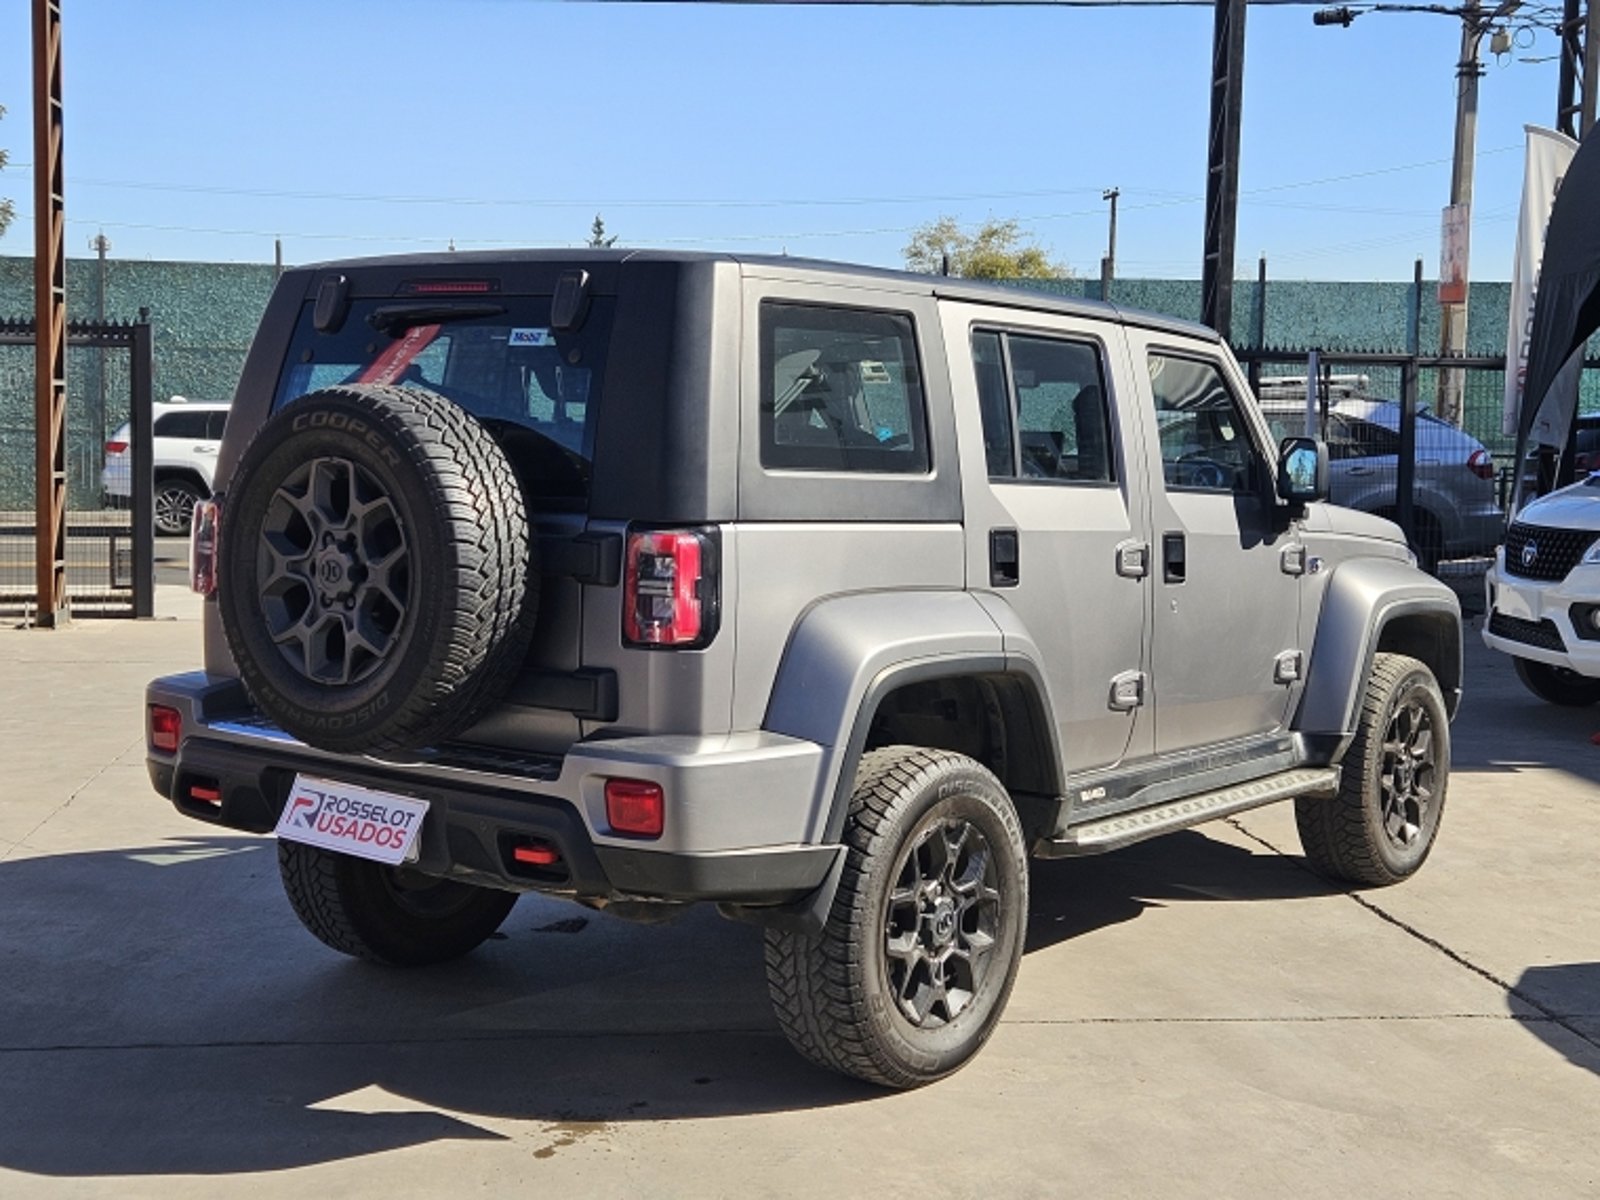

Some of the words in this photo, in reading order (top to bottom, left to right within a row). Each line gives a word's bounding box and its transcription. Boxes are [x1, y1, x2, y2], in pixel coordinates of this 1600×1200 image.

[291, 409, 402, 468] COOPER
[323, 795, 416, 828] ROSSELOT
[316, 812, 407, 850] USADOS
